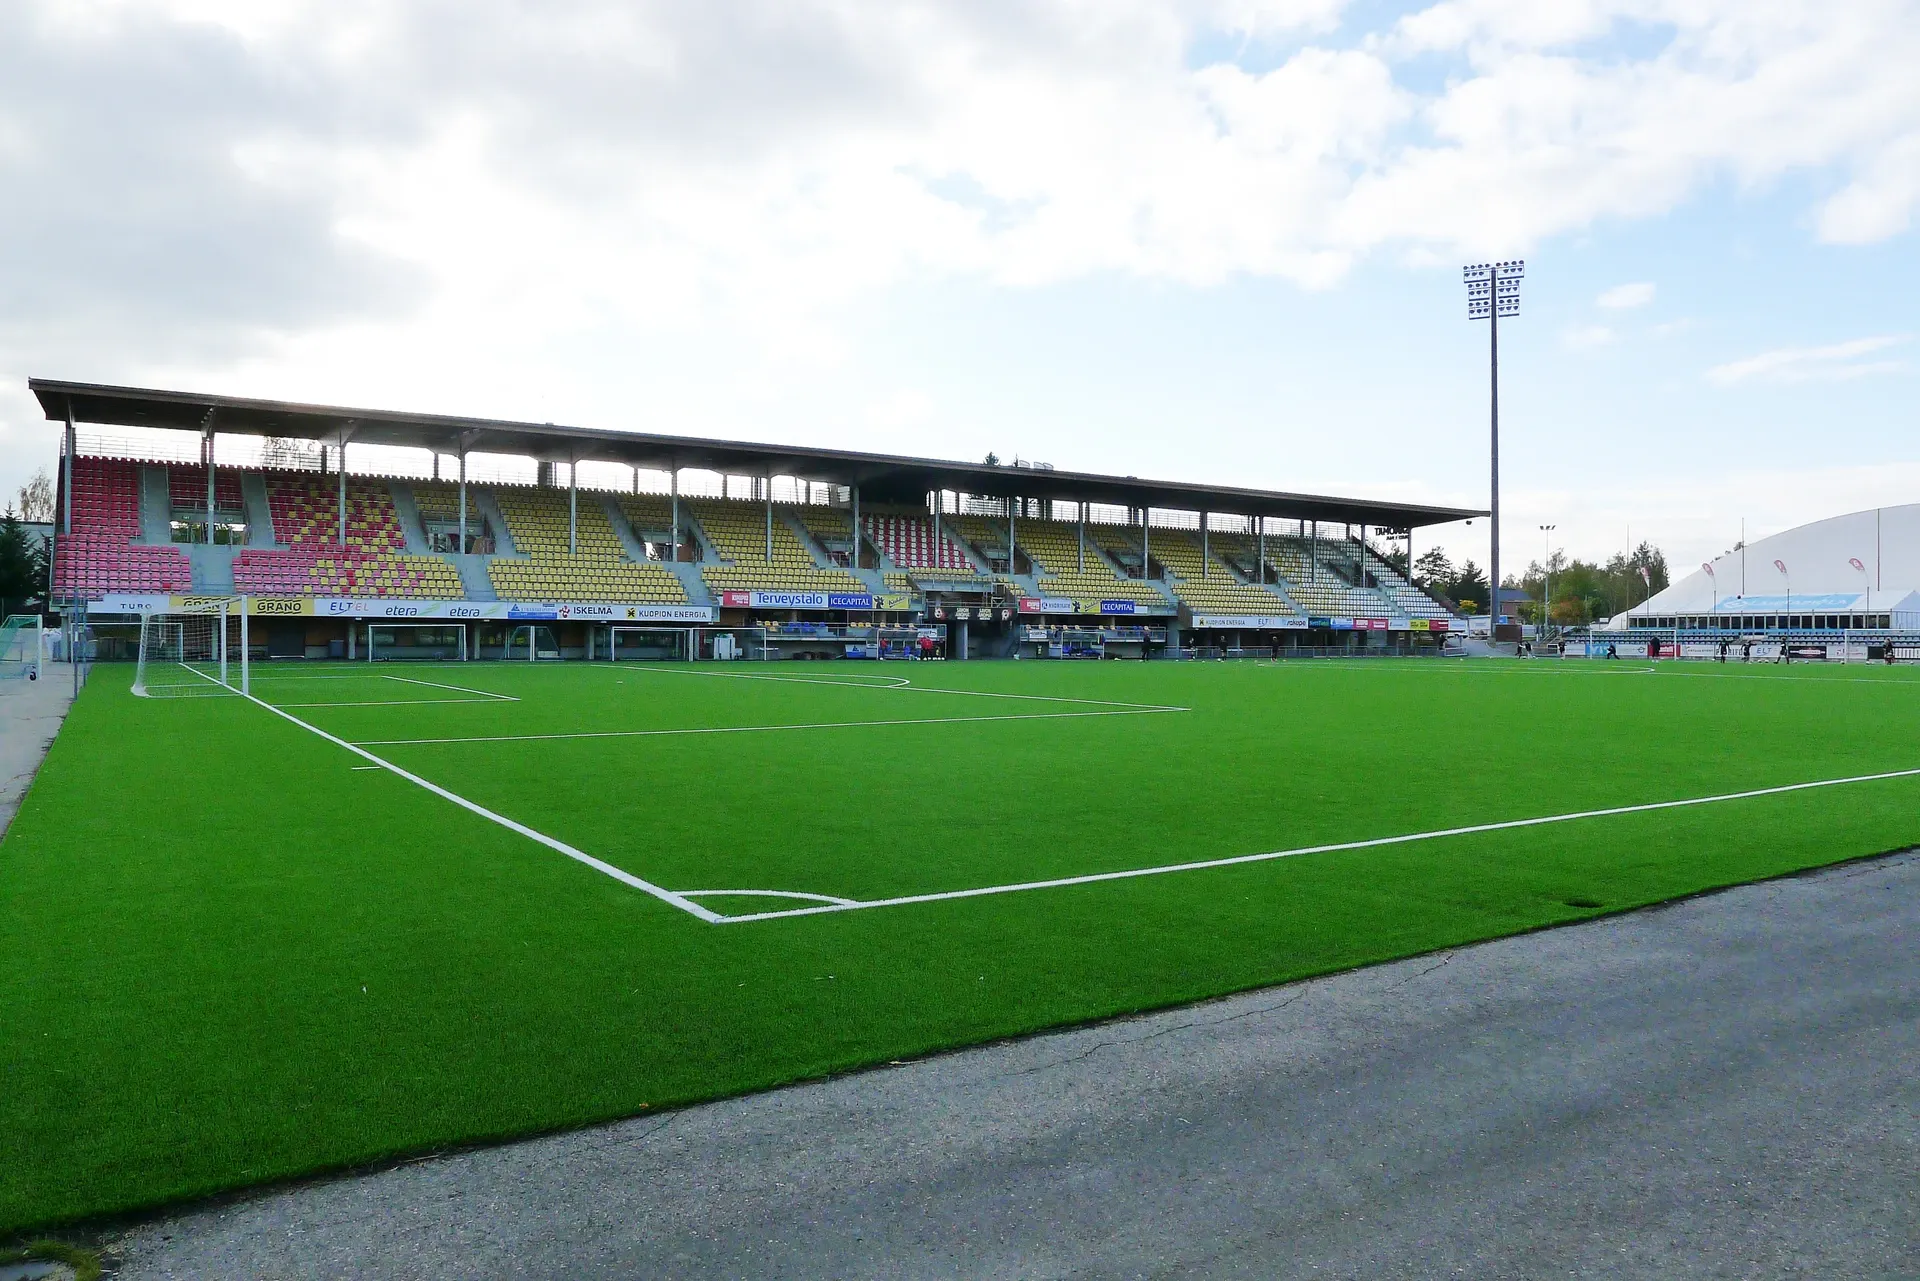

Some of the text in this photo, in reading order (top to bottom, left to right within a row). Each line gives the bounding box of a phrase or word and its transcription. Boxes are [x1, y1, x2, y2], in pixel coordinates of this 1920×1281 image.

[757, 592, 823, 606] Terveystalo
[830, 597, 870, 606] ICECAPITAL
[257, 602, 302, 612] GRANO
[385, 605, 418, 617] etera
[1101, 602, 1134, 611] ICECAPITAL
[449, 607, 480, 617] etera
[638, 610, 707, 619] KUOPION ENERGIA
